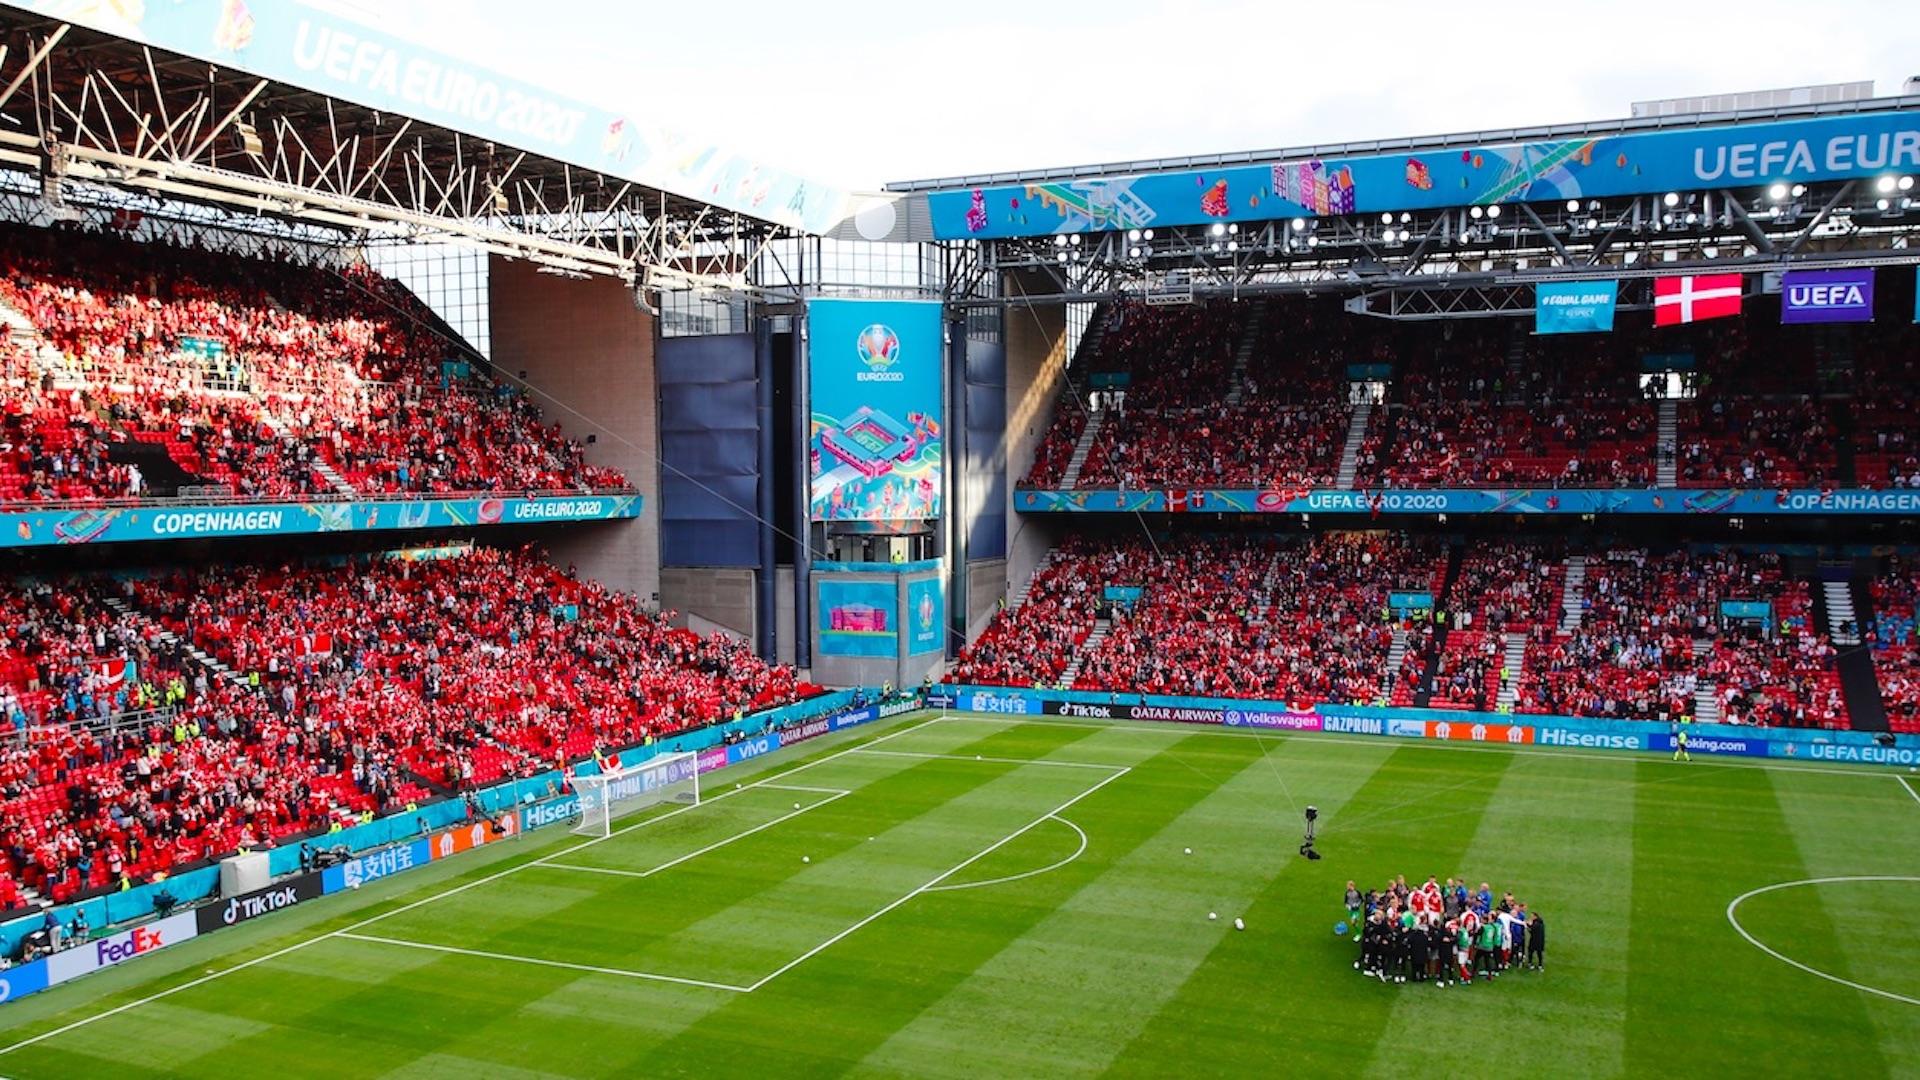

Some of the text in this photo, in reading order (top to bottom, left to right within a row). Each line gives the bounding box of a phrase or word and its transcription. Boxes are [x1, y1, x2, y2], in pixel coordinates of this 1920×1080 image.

[293, 20, 586, 147] UEFA EURO 2020
[1694, 140, 1816, 180] UEFA
[1581, 294, 1610, 305] GAME
[1790, 286, 1864, 306] UEFA
[514, 501, 602, 518] UEFA EURO 2020
[1309, 495, 1353, 508] UEFA
[1403, 495, 1447, 509] 2020
[153, 511, 282, 534] COPENHAGEN
[879, 700, 915, 717] Heineken
[987, 697, 1027, 714] 支付宝
[1072, 704, 1110, 718] TikTok
[1131, 706, 1224, 722] QATAR AIRWAYS
[1244, 712, 1318, 728] Volkswagen
[1324, 716, 1382, 734] GAZPROM
[780, 729, 801, 744] QATAR
[1541, 729, 1640, 749] Hisense
[1670, 735, 1746, 752] Boking.com
[739, 740, 768, 759] vivo
[1811, 743, 1859, 760] UEFA
[1861, 747, 1913, 764] EURO
[364, 844, 413, 883] 支付宝
[242, 886, 298, 918] TikTok
[97, 926, 164, 967] FedEx
